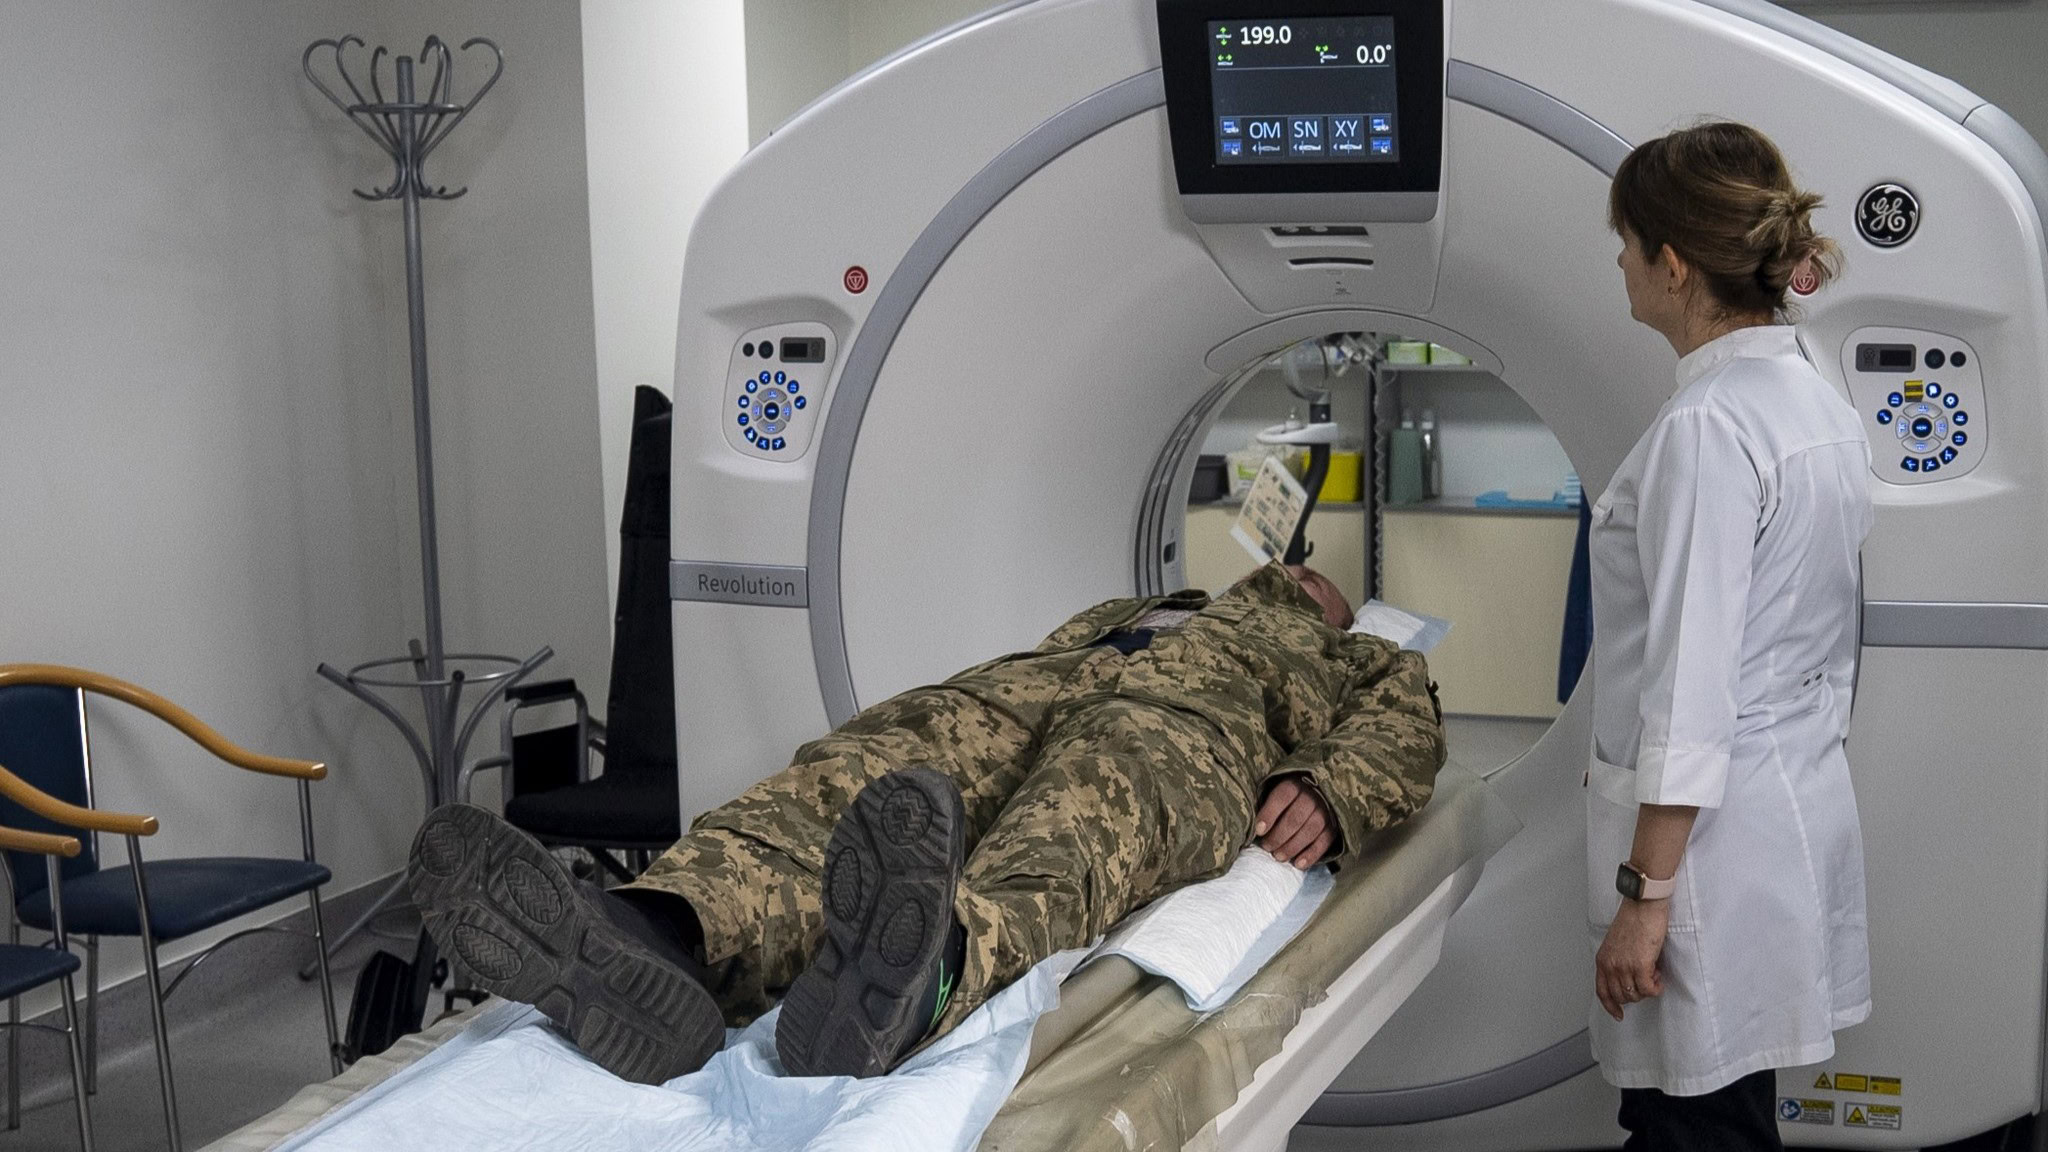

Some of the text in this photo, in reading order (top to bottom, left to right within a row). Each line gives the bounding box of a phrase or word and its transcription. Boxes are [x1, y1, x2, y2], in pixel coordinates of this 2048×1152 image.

[1240, 25, 1292, 46] 199.0
[1356, 44, 1392, 64] 0.0°
[1249, 121, 1281, 139] OM
[1293, 120, 1318, 138] SN
[1334, 119, 1359, 137] XY
[698, 573, 795, 597] Revolution
